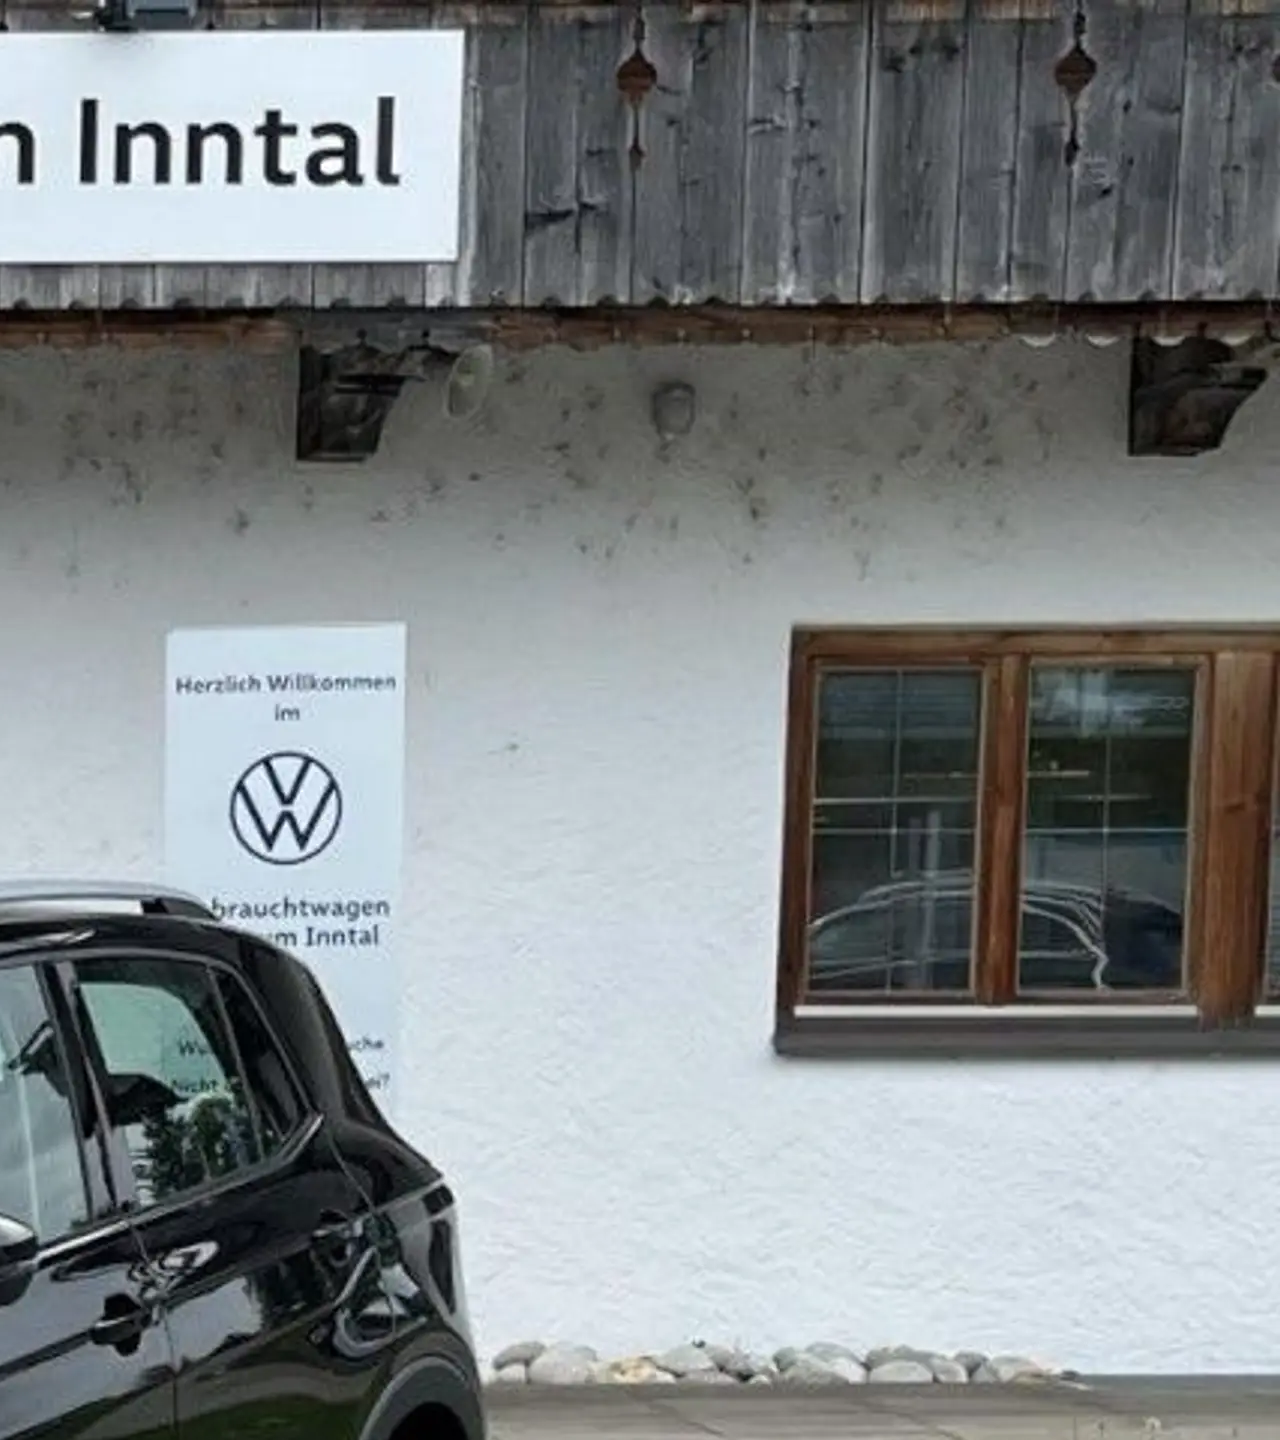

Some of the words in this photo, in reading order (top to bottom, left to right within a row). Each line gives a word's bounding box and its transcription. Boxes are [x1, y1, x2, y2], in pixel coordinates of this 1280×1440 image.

[78, 96, 402, 187] Inntal
[176, 675, 262, 694] Herzlich
[266, 673, 397, 693] Willkommen
[274, 704, 301, 721] im
[211, 896, 391, 921] brauchtwagen
[307, 924, 380, 946] Inntal
